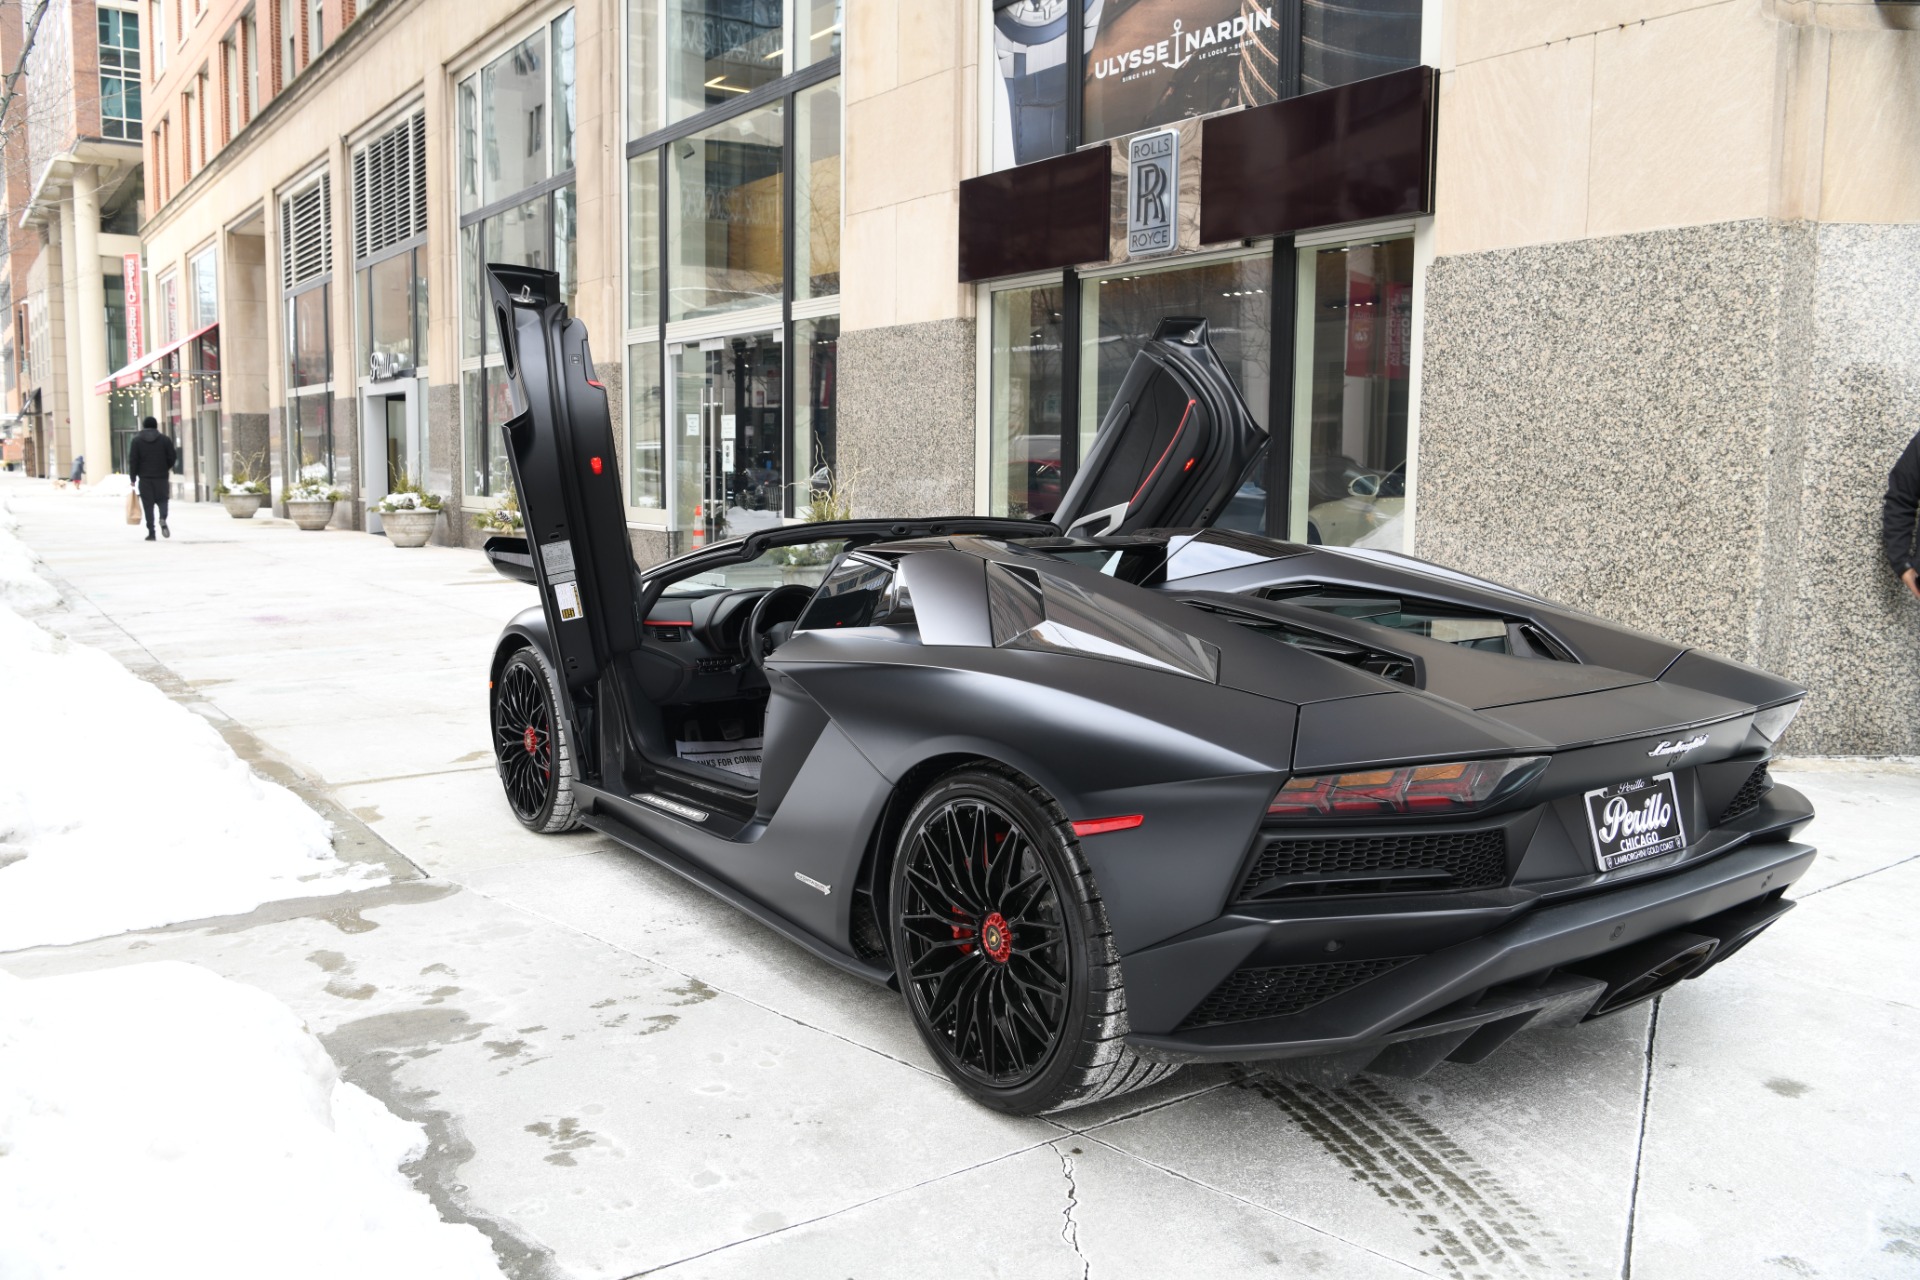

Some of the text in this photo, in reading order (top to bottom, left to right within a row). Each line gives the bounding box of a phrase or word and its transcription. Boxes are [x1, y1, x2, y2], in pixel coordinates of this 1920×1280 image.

[1095, 7, 1272, 79] ULYSSE NARDIN
[1207, 46, 1228, 58] LOCLE
[1122, 72, 1140, 83] SINCE
[1134, 138, 1170, 159] ROLLS
[1131, 229, 1168, 248] ROYCE
[127, 259, 139, 362] EPIC BURGE
[717, 758, 733, 767] FOR
[733, 755, 763, 765] COMING
[1617, 778, 1645, 794] Perillo
[1598, 792, 1672, 844] Perillo
[1620, 831, 1659, 852] CHICAGO
[1613, 840, 1675, 865] LAMBORGHINI GOLD COAST
